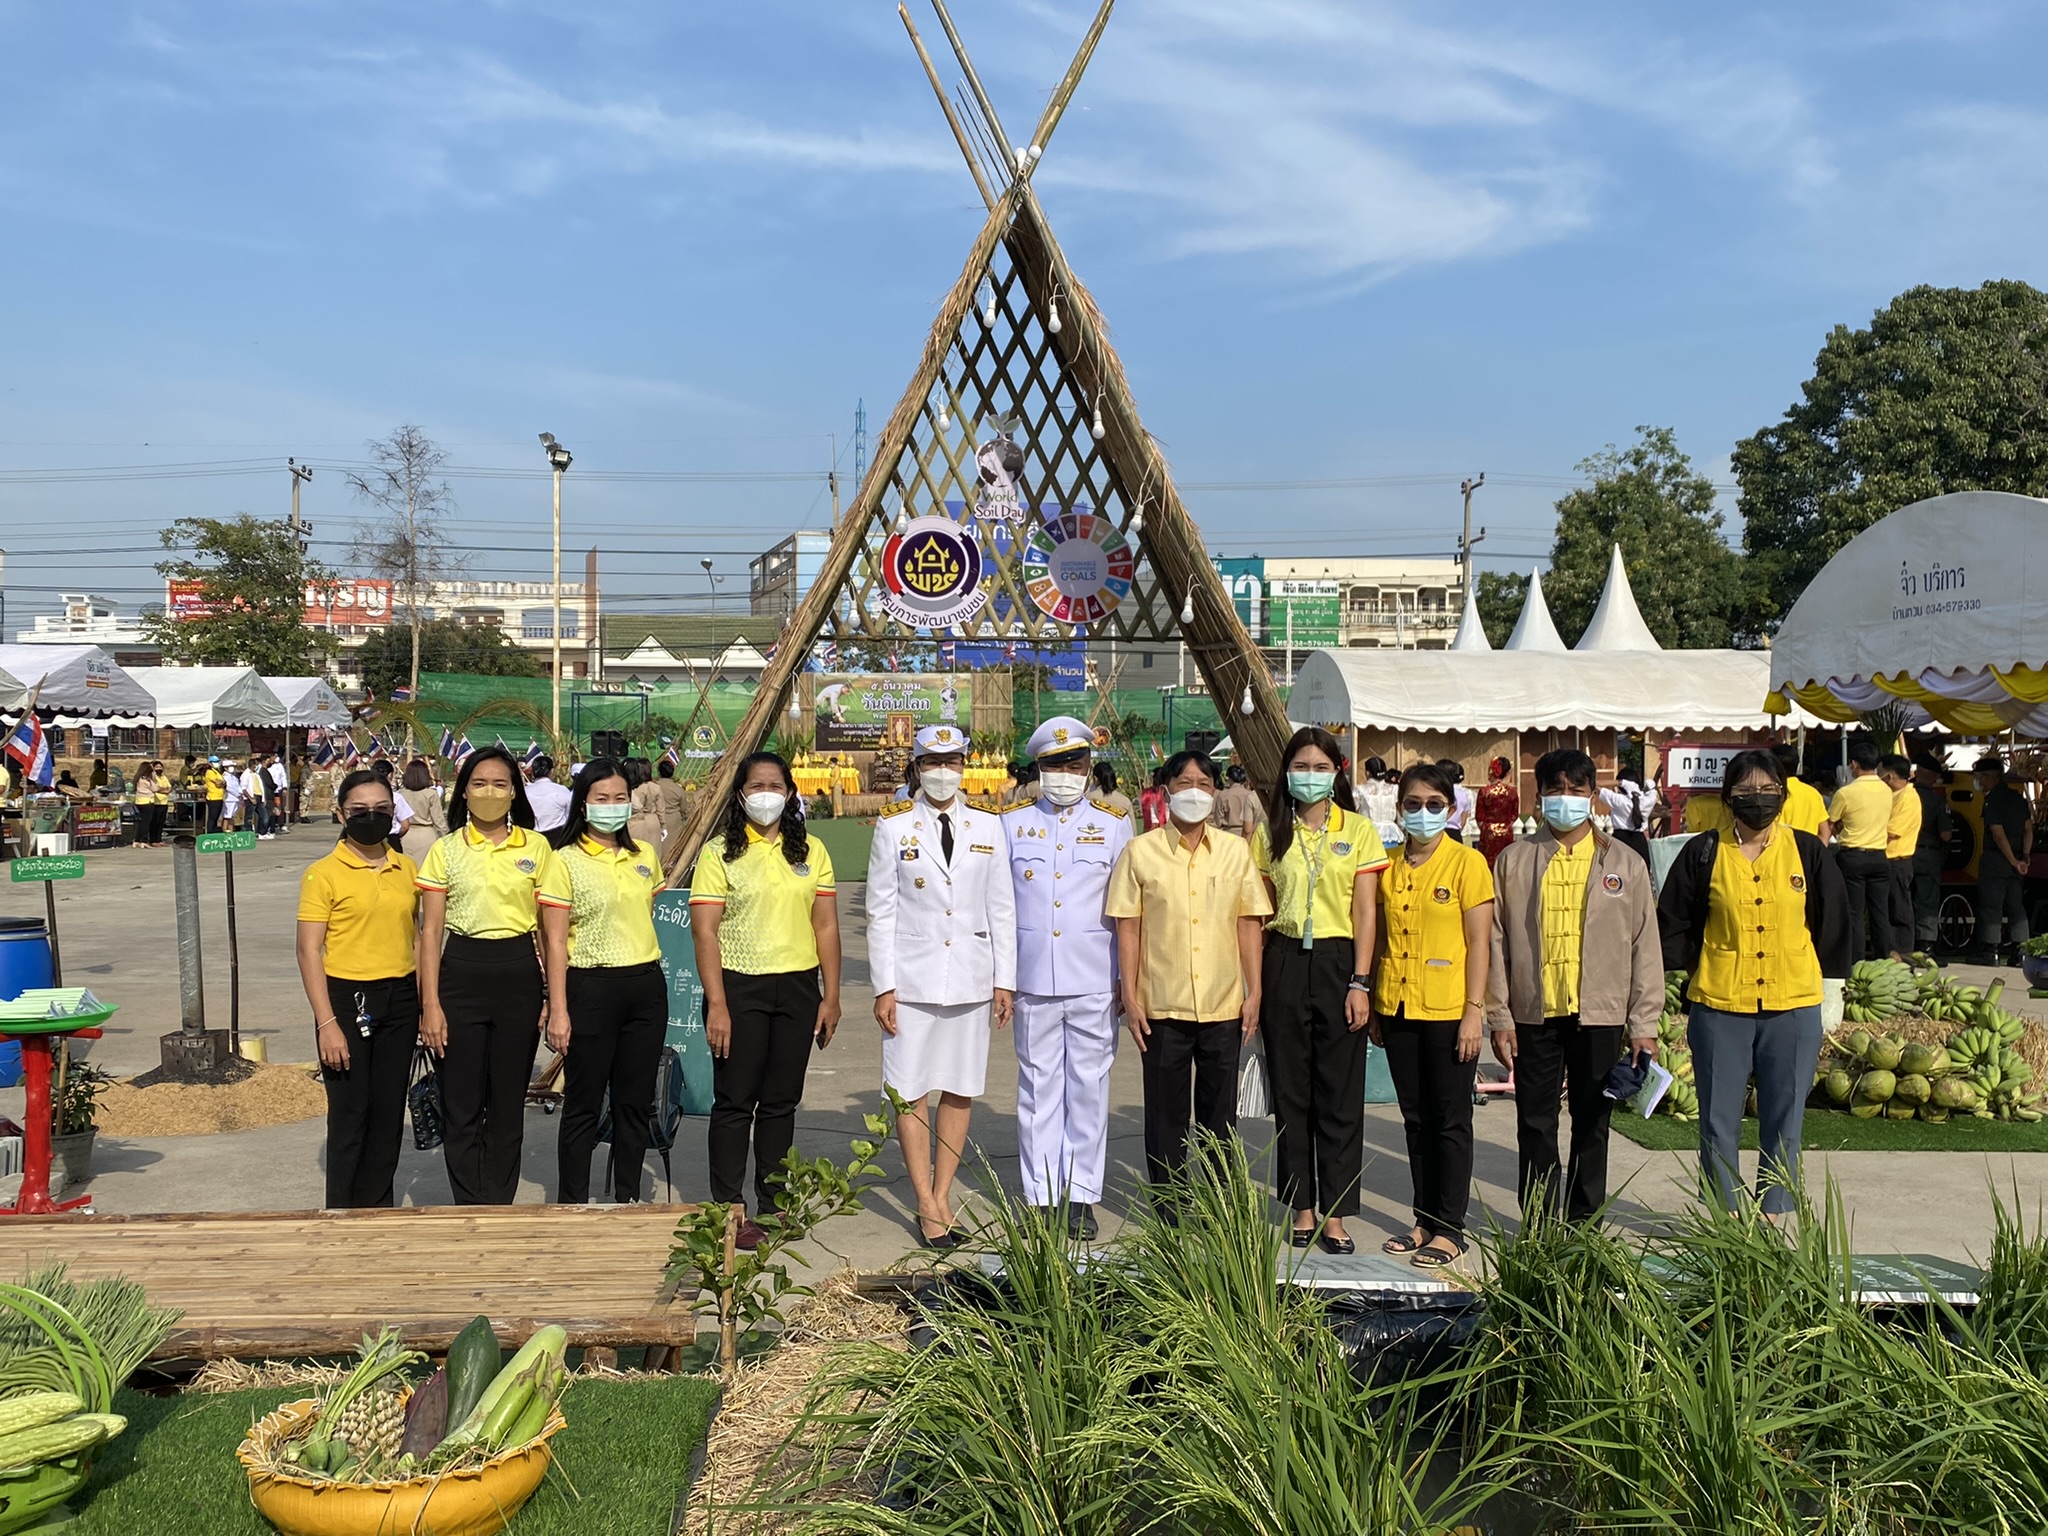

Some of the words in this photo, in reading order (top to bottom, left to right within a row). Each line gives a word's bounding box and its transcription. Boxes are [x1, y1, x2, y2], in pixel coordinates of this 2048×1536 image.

[983, 490, 1018, 503] World
[975, 505, 998, 518] Soil
[1001, 505, 1025, 521] Day
[1060, 571, 1097, 581] GOALS
[1923, 562, 1965, 592] บริการ
[876, 591, 987, 626] กรมการพัฒนาชุมชน
[883, 679, 921, 691] ธันวาคม
[862, 690, 931, 711] วันดินโลก
[658, 899, 691, 928] ระดับ
